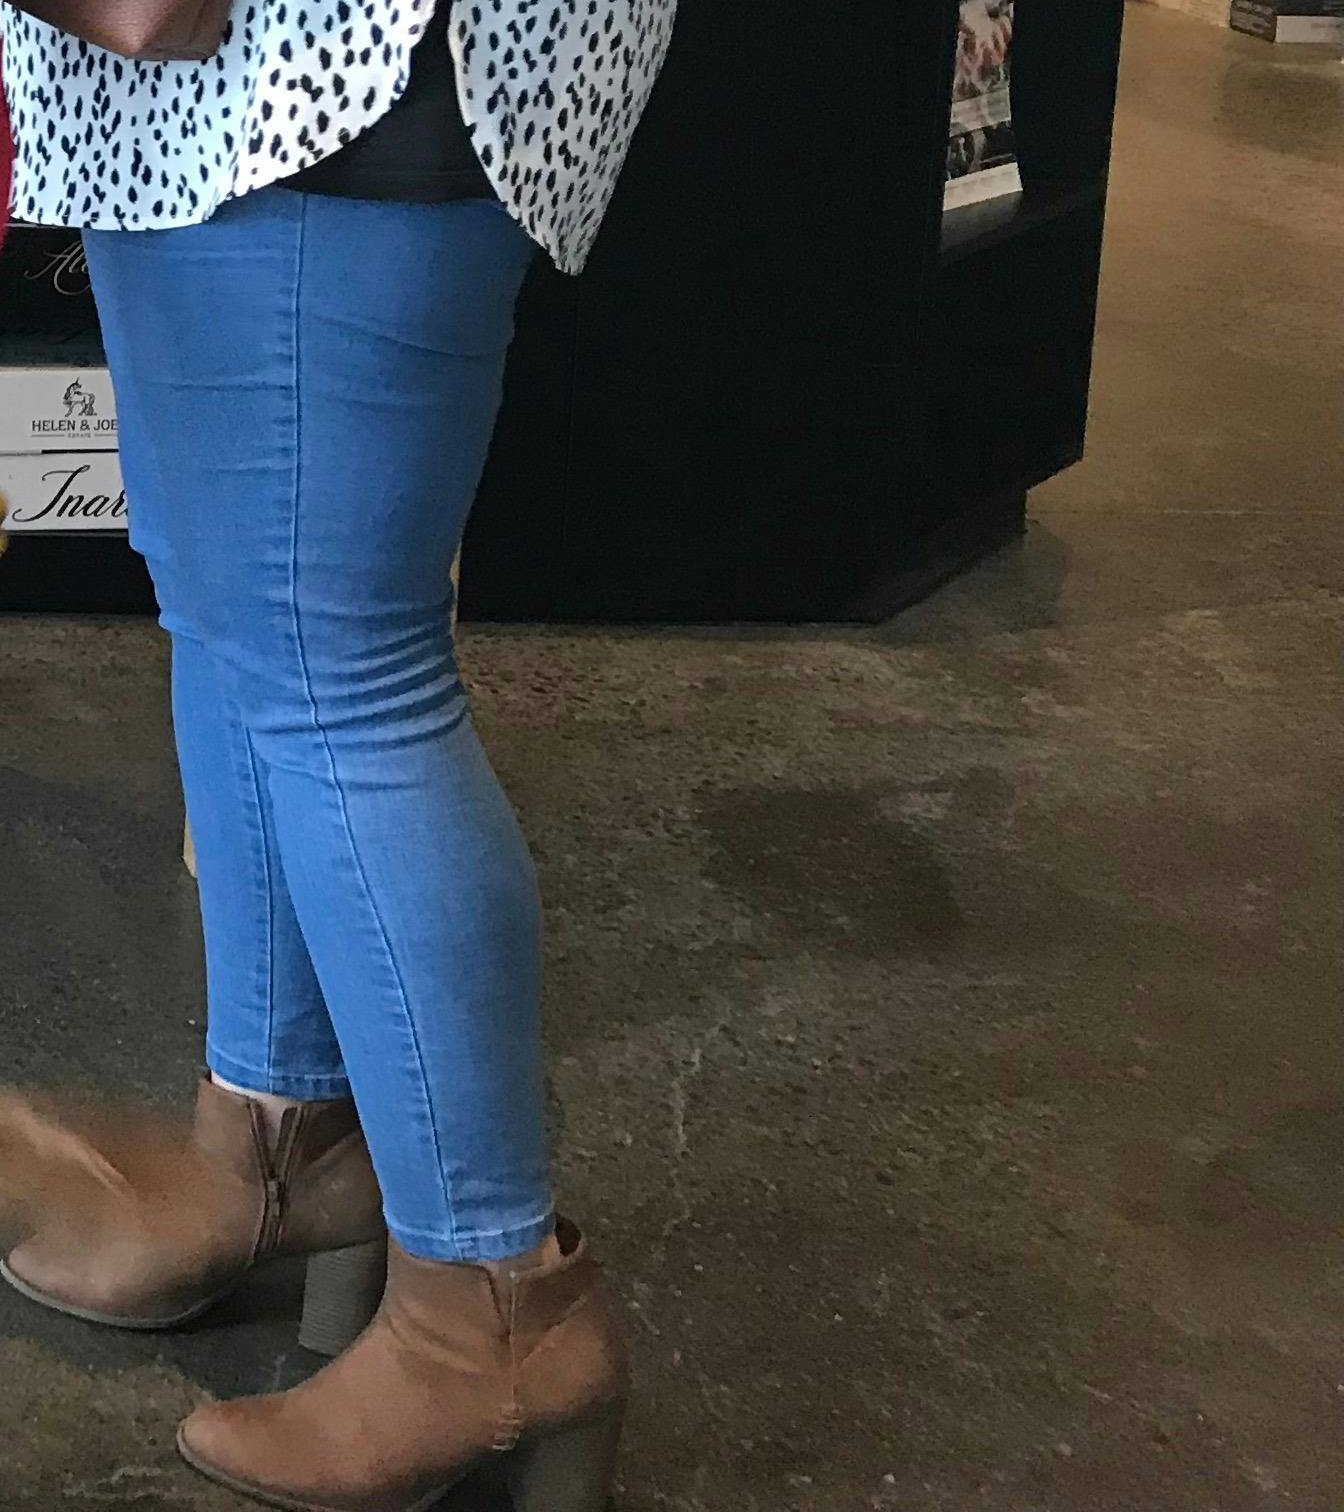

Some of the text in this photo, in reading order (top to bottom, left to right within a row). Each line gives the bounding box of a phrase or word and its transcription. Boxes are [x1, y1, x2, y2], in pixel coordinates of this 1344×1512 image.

[32, 419, 119, 431] HELEN & JOE
[12, 464, 129, 523] Inar
